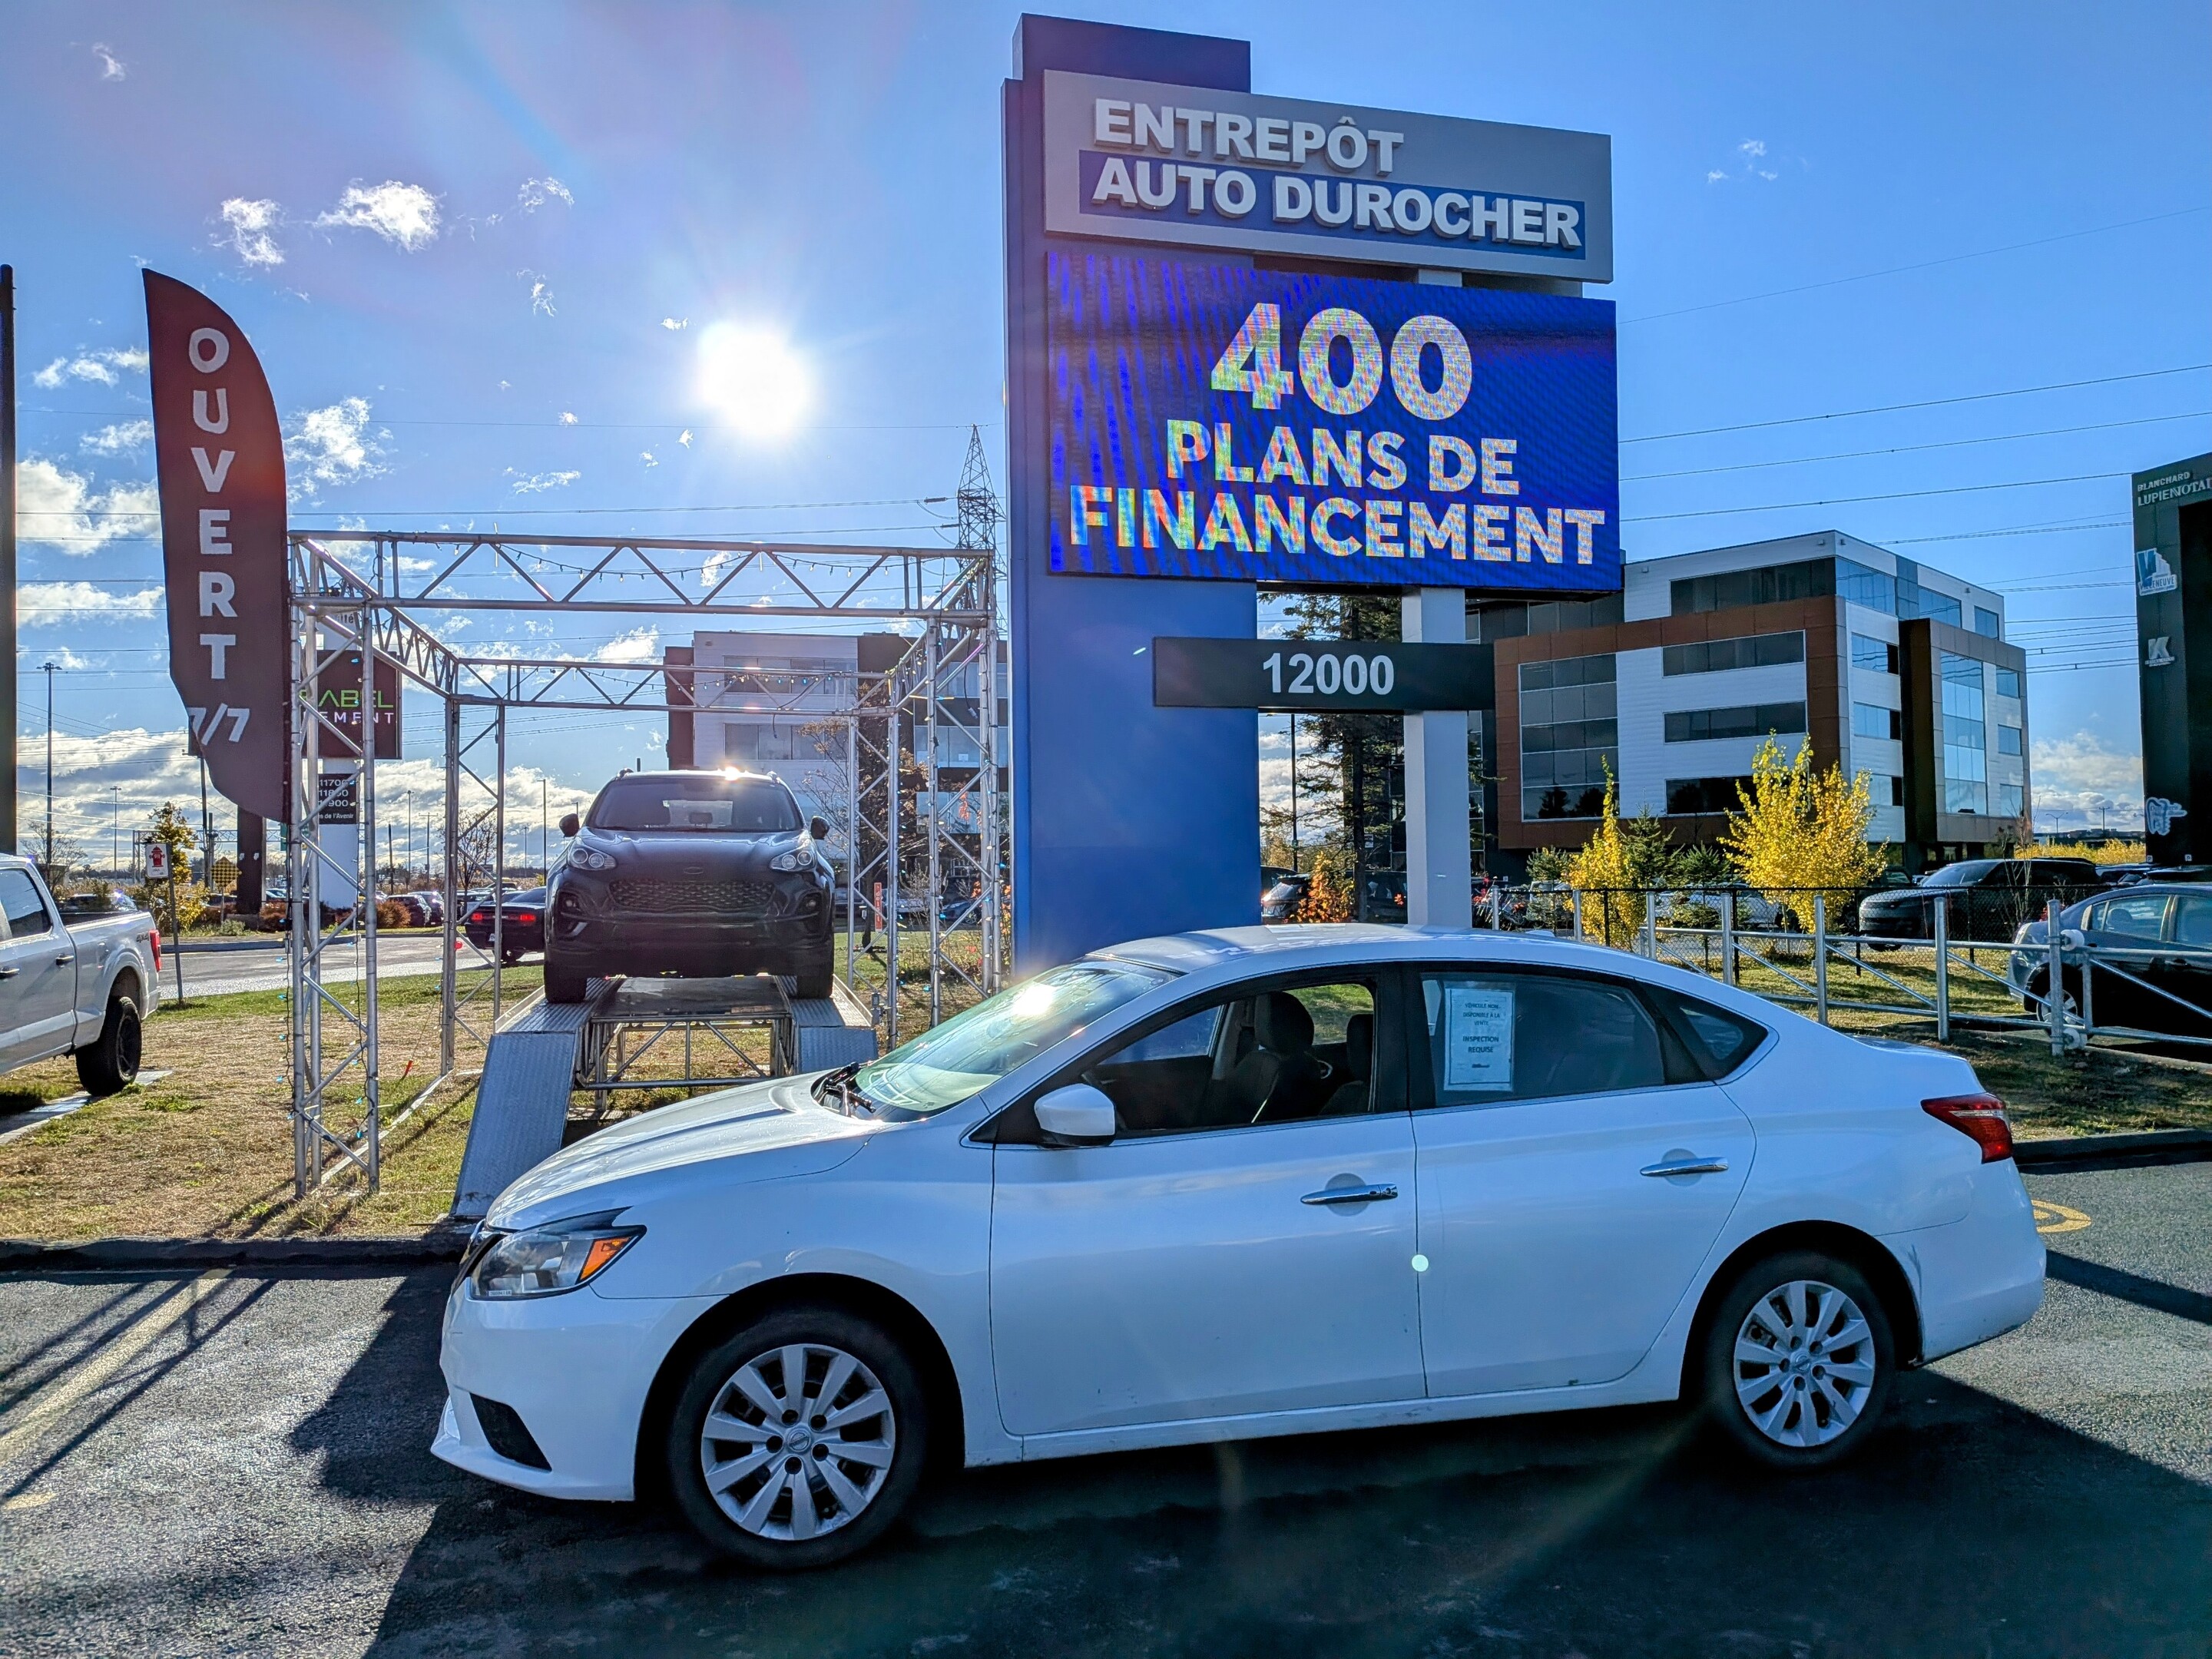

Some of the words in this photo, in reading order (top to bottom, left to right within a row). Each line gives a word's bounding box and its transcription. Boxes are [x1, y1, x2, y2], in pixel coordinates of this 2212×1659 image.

[1094, 98, 1404, 175] ENTREPÔT
[1092, 157, 1257, 219] AUTO
[1272, 177, 1583, 250] DUROCHER
[1210, 303, 1472, 420] 400
[1167, 419, 1407, 490] PLANS
[1429, 435, 1520, 495] DE
[2137, 472, 2190, 492] BLANCHARD
[188, 327, 238, 680] OUVERT
[1070, 485, 1605, 565] FINANCEMENT
[1263, 653, 1395, 695] 12000
[187, 703, 250, 746] 7/7
